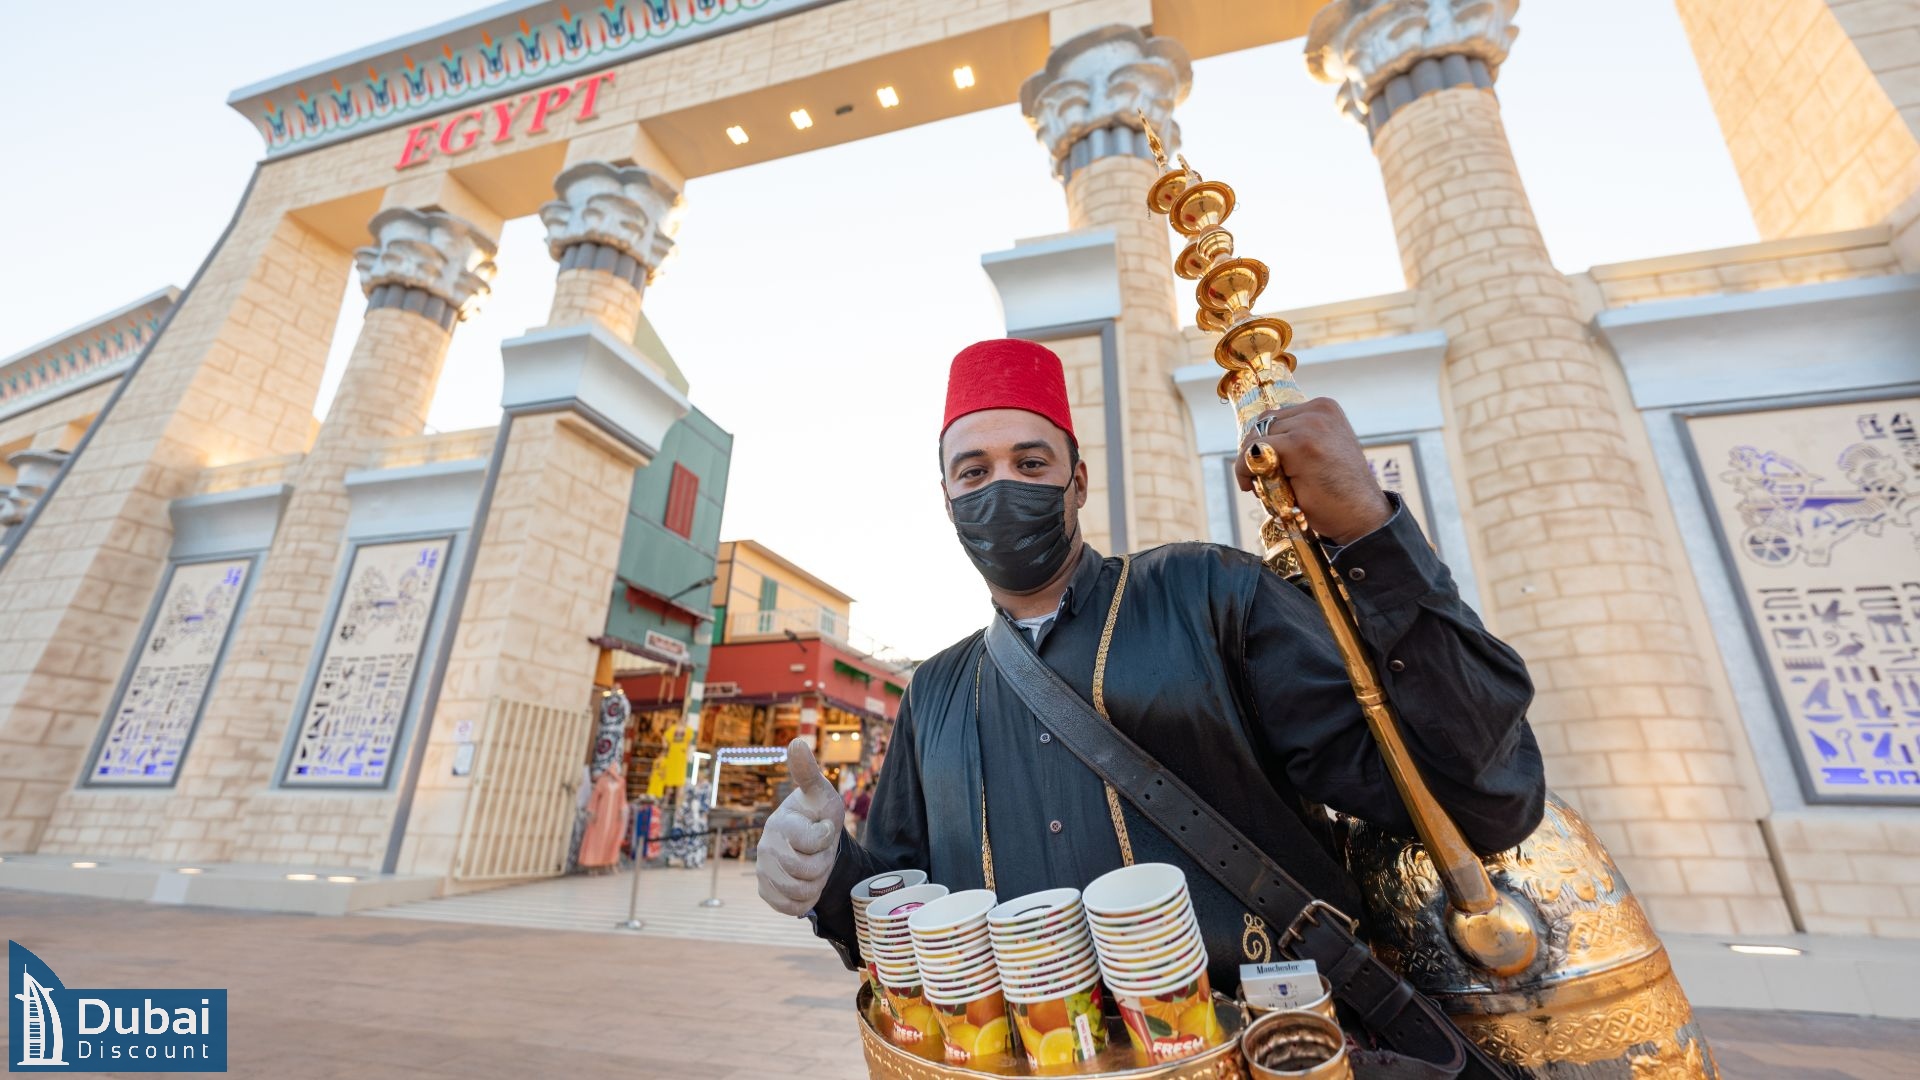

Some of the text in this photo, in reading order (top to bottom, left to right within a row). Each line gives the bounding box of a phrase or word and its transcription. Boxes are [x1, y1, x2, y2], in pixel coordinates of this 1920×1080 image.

[395, 72, 615, 171] EGYPT
[1256, 963, 1300, 974] Manchester
[1152, 1035, 1204, 1056] FRESH
